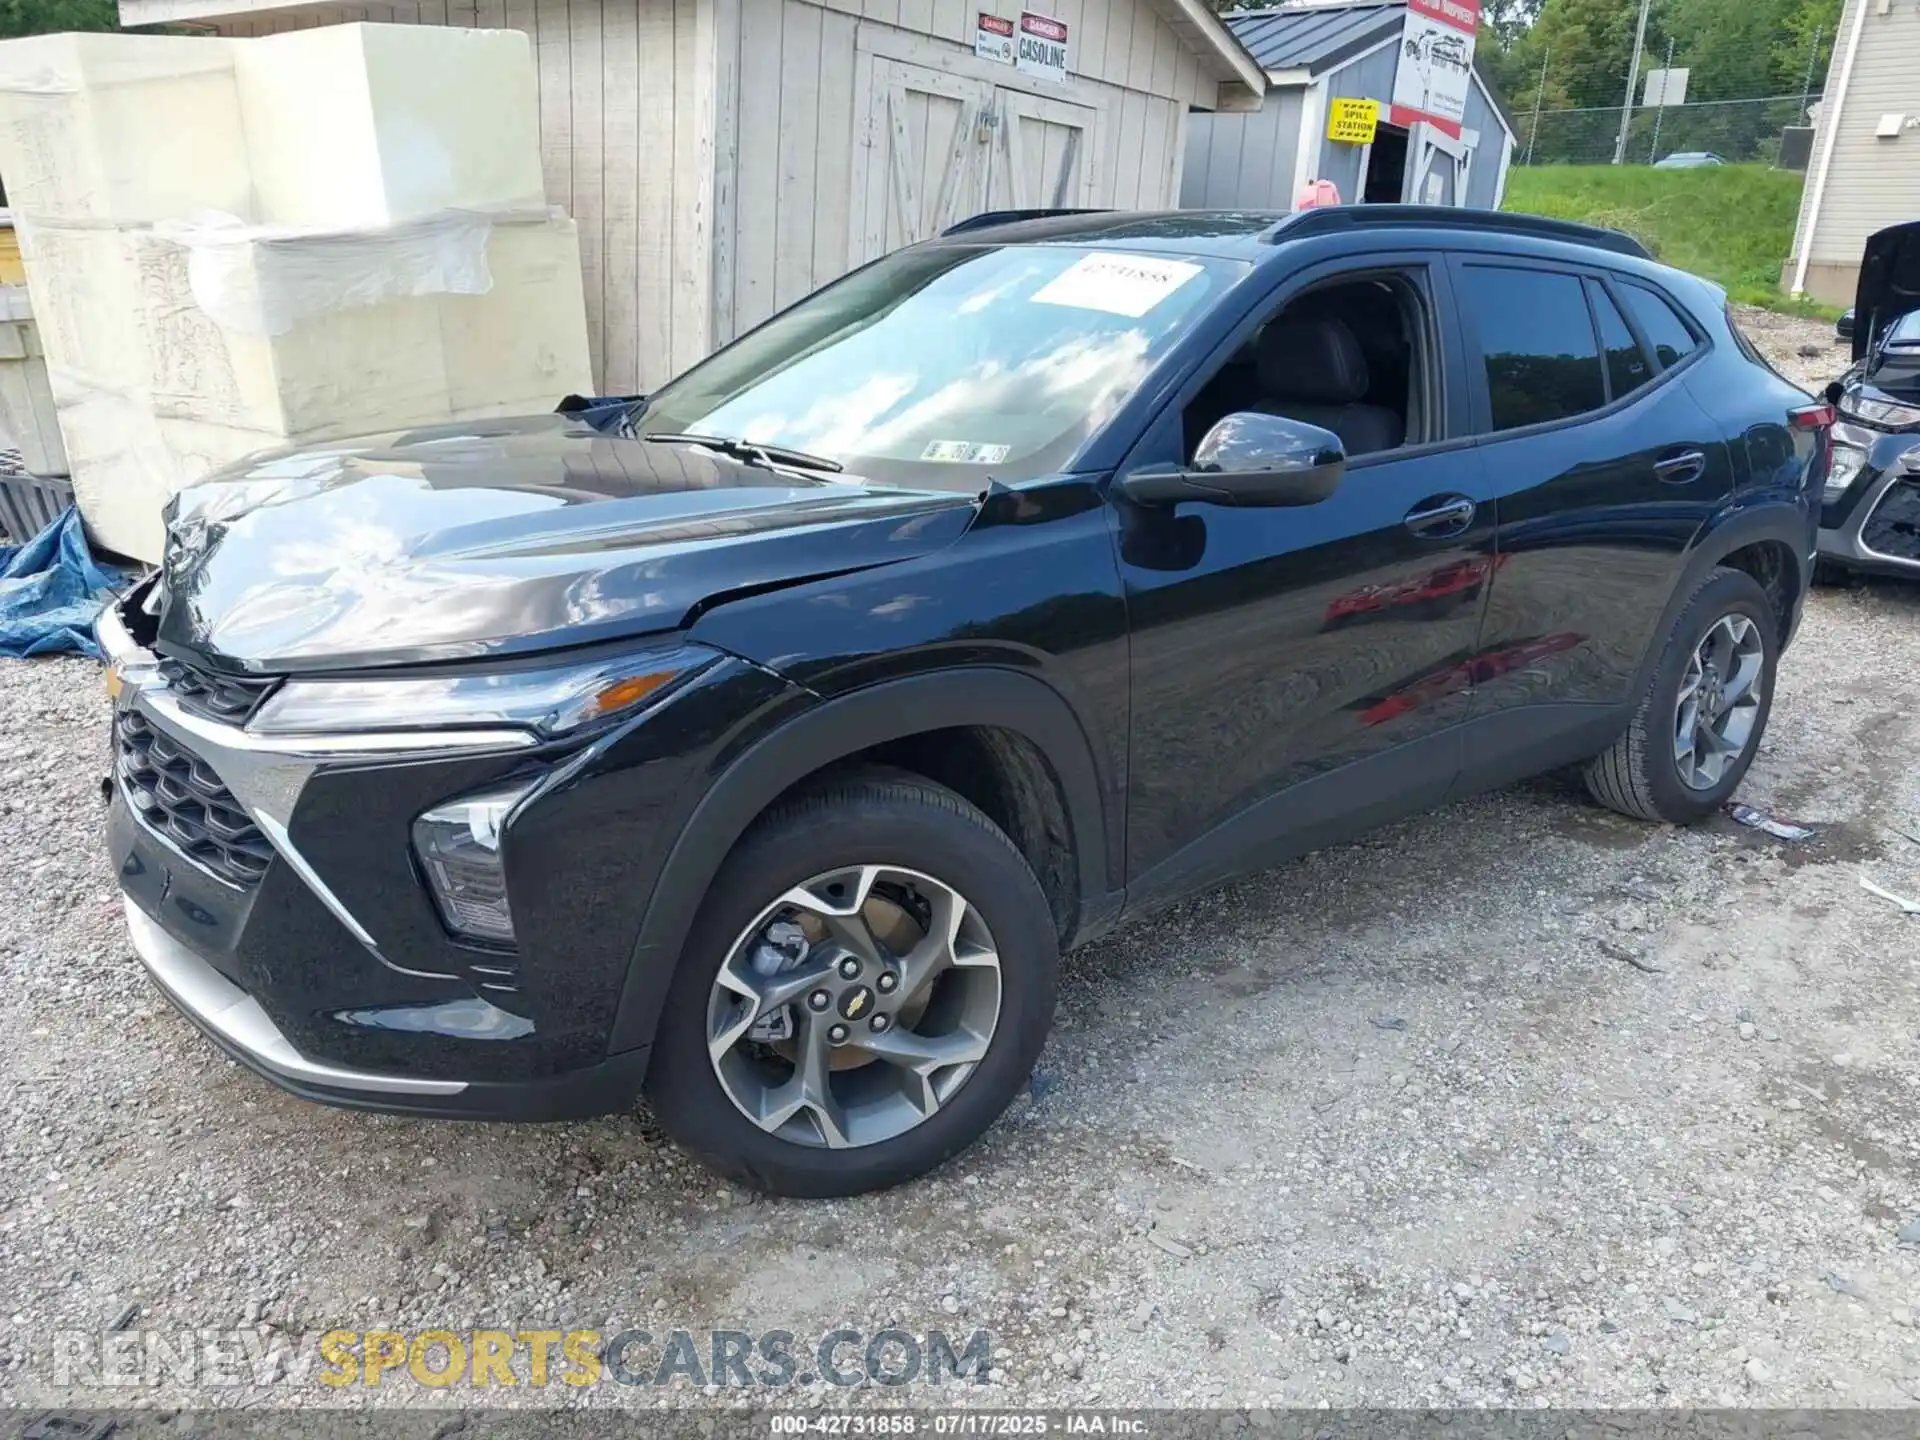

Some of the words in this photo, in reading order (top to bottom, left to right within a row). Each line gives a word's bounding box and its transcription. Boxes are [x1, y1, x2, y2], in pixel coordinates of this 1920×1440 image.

[1029, 19, 1060, 37] DANGER
[1019, 37, 1066, 69] GASOLINE
[1343, 110, 1369, 121] SPILL
[1336, 120, 1373, 131] STATION
